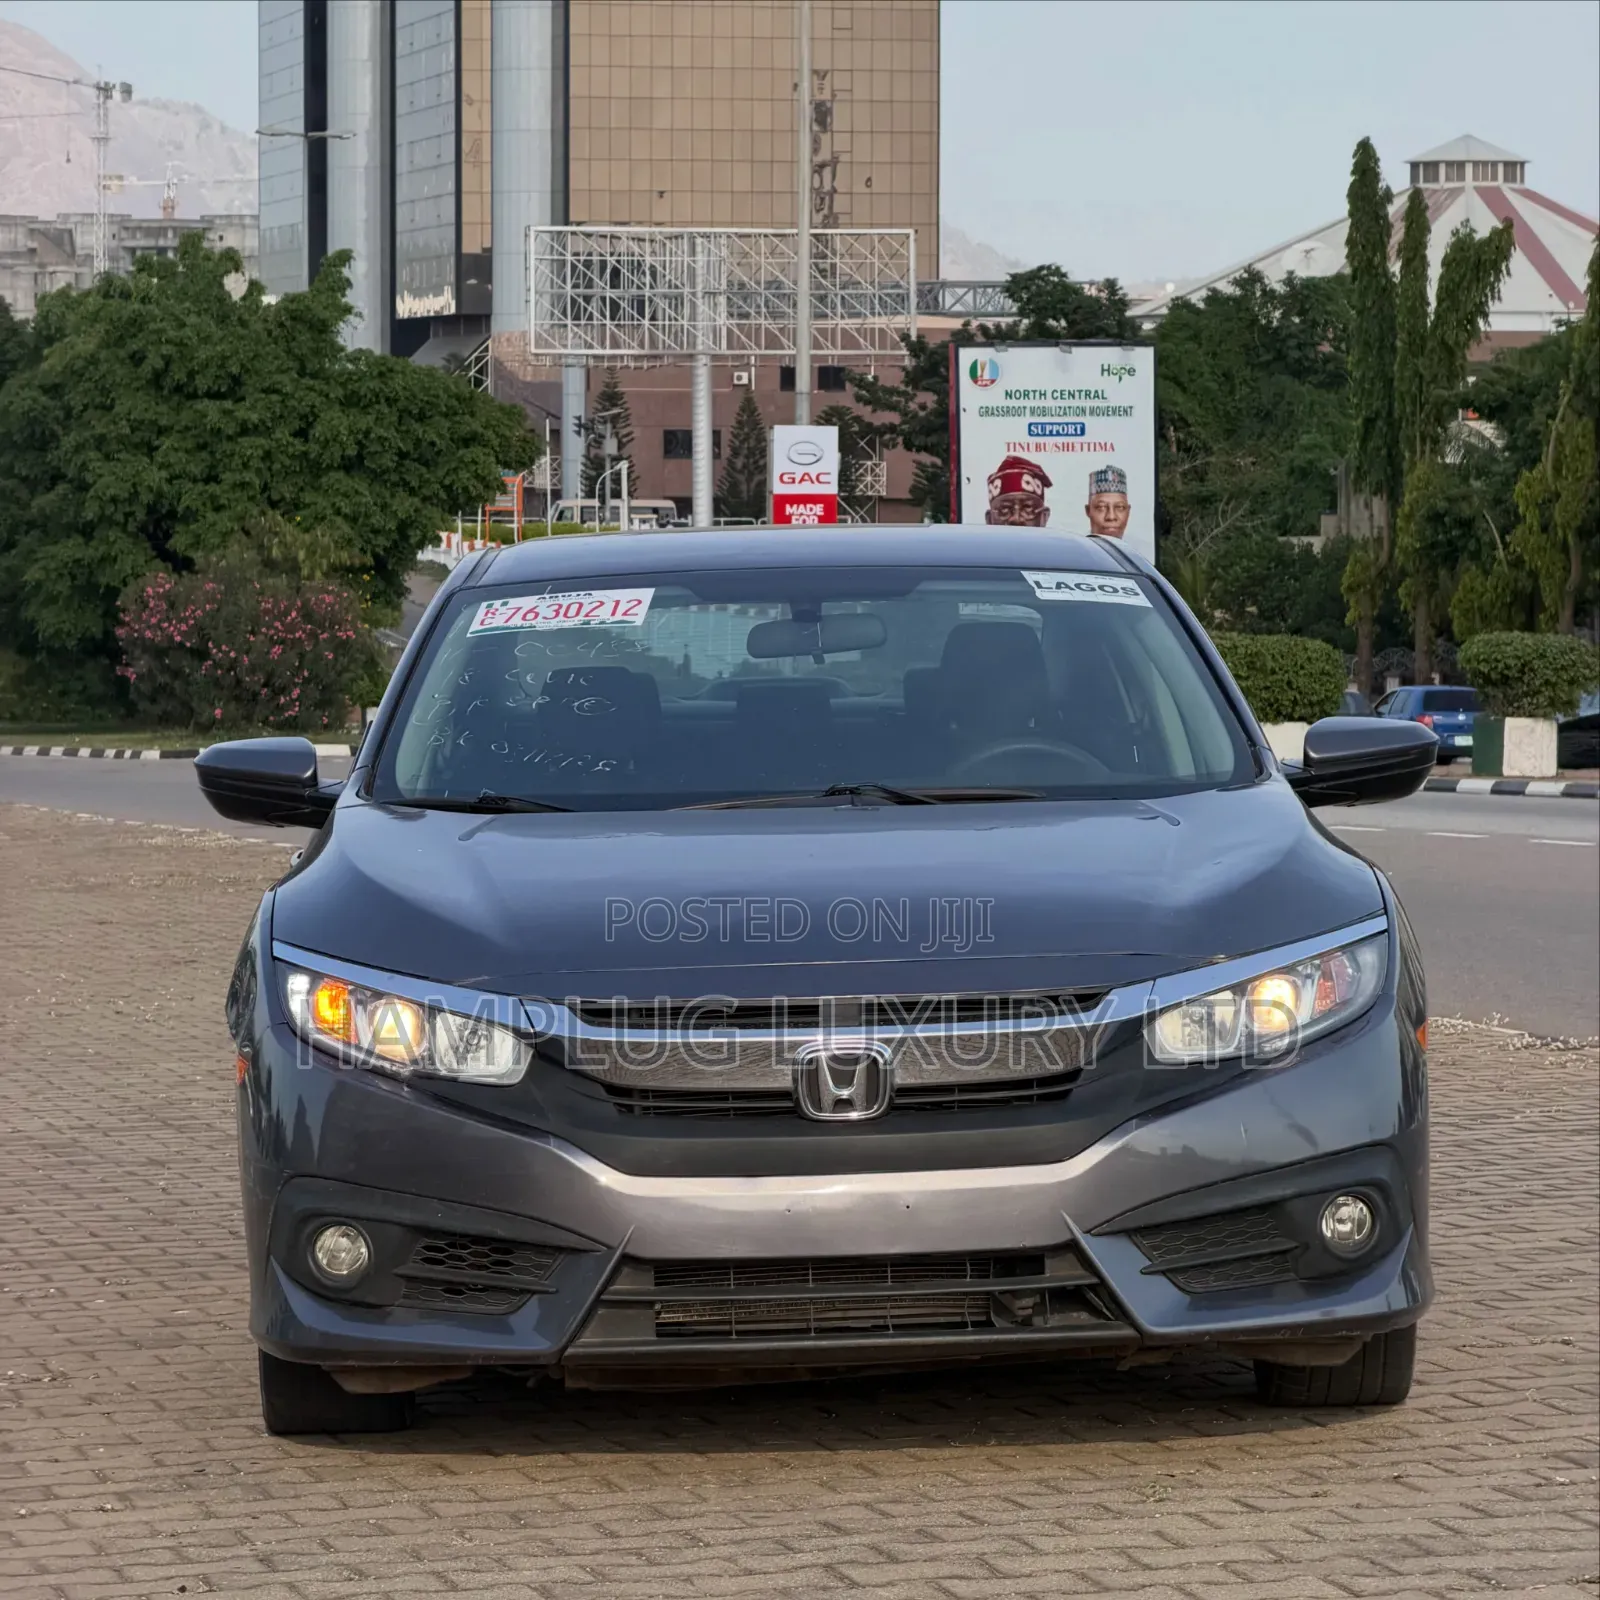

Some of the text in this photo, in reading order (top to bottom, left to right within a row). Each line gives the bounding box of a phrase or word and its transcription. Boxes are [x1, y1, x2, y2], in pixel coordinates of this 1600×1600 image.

[1100, 362, 1137, 383] Hope
[1004, 389, 1108, 401] NORTH CENTRAL
[978, 405, 1134, 417] GRASSROOT MOBILIZATION MOVEMENT
[1030, 424, 1083, 435] SUPPORT
[1005, 442, 1115, 453] TINUBU/SHETTIMA
[778, 472, 832, 485] GAC
[785, 503, 824, 516] MADE
[1032, 580, 1141, 597] LAGOS
